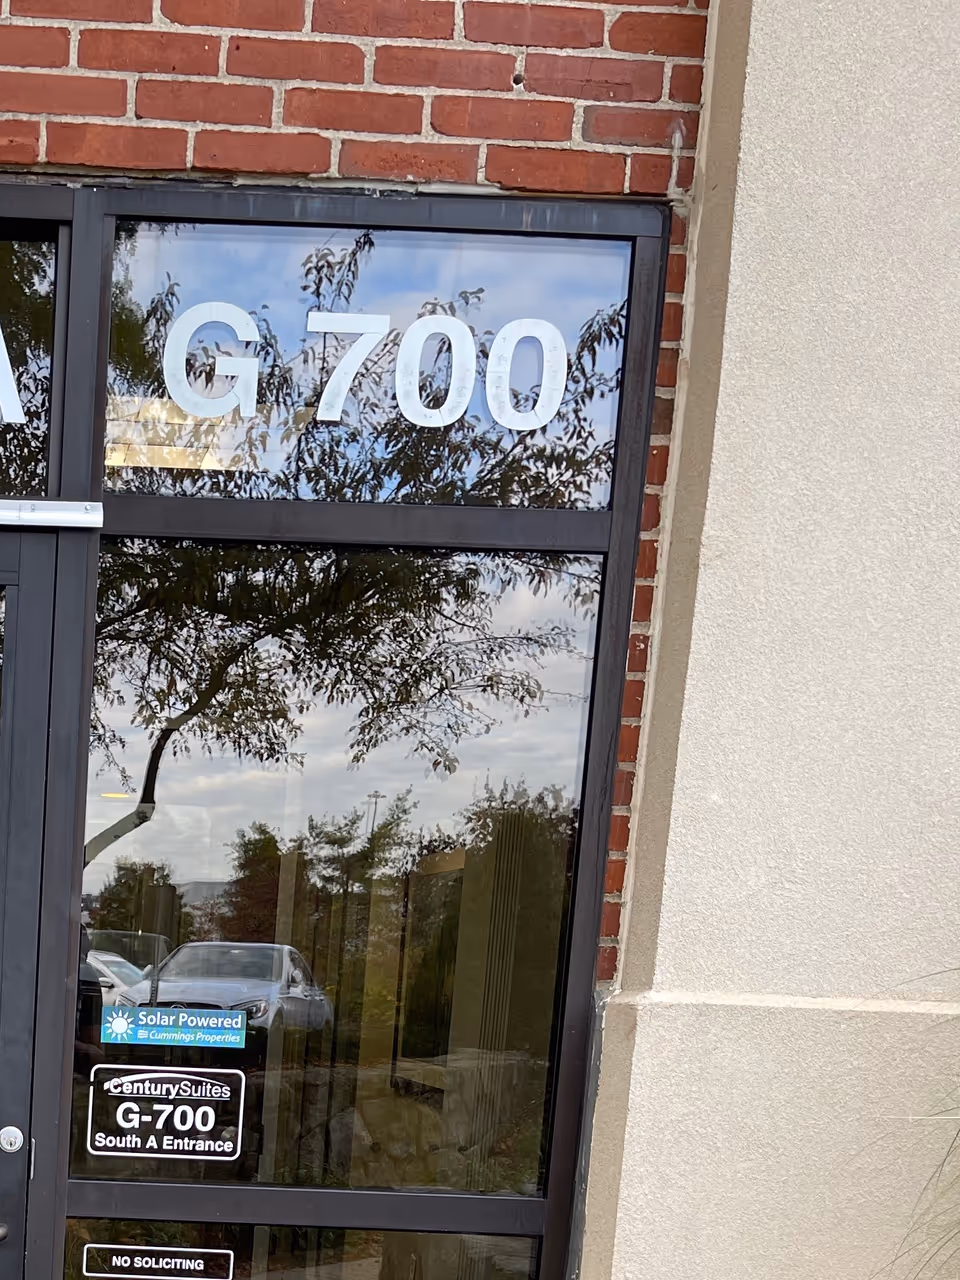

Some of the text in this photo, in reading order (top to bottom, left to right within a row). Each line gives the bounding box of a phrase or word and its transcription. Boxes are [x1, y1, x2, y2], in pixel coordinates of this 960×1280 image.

[163, 302, 569, 431] G 700
[138, 1011, 241, 1028] Solar Powered
[149, 1030, 240, 1043] Cummings Properties
[109, 1078, 231, 1099] CenturySuites
[116, 1101, 216, 1132] G-700
[94, 1132, 234, 1152] South A Entrance
[112, 1256, 204, 1270] NO SOLICITING
